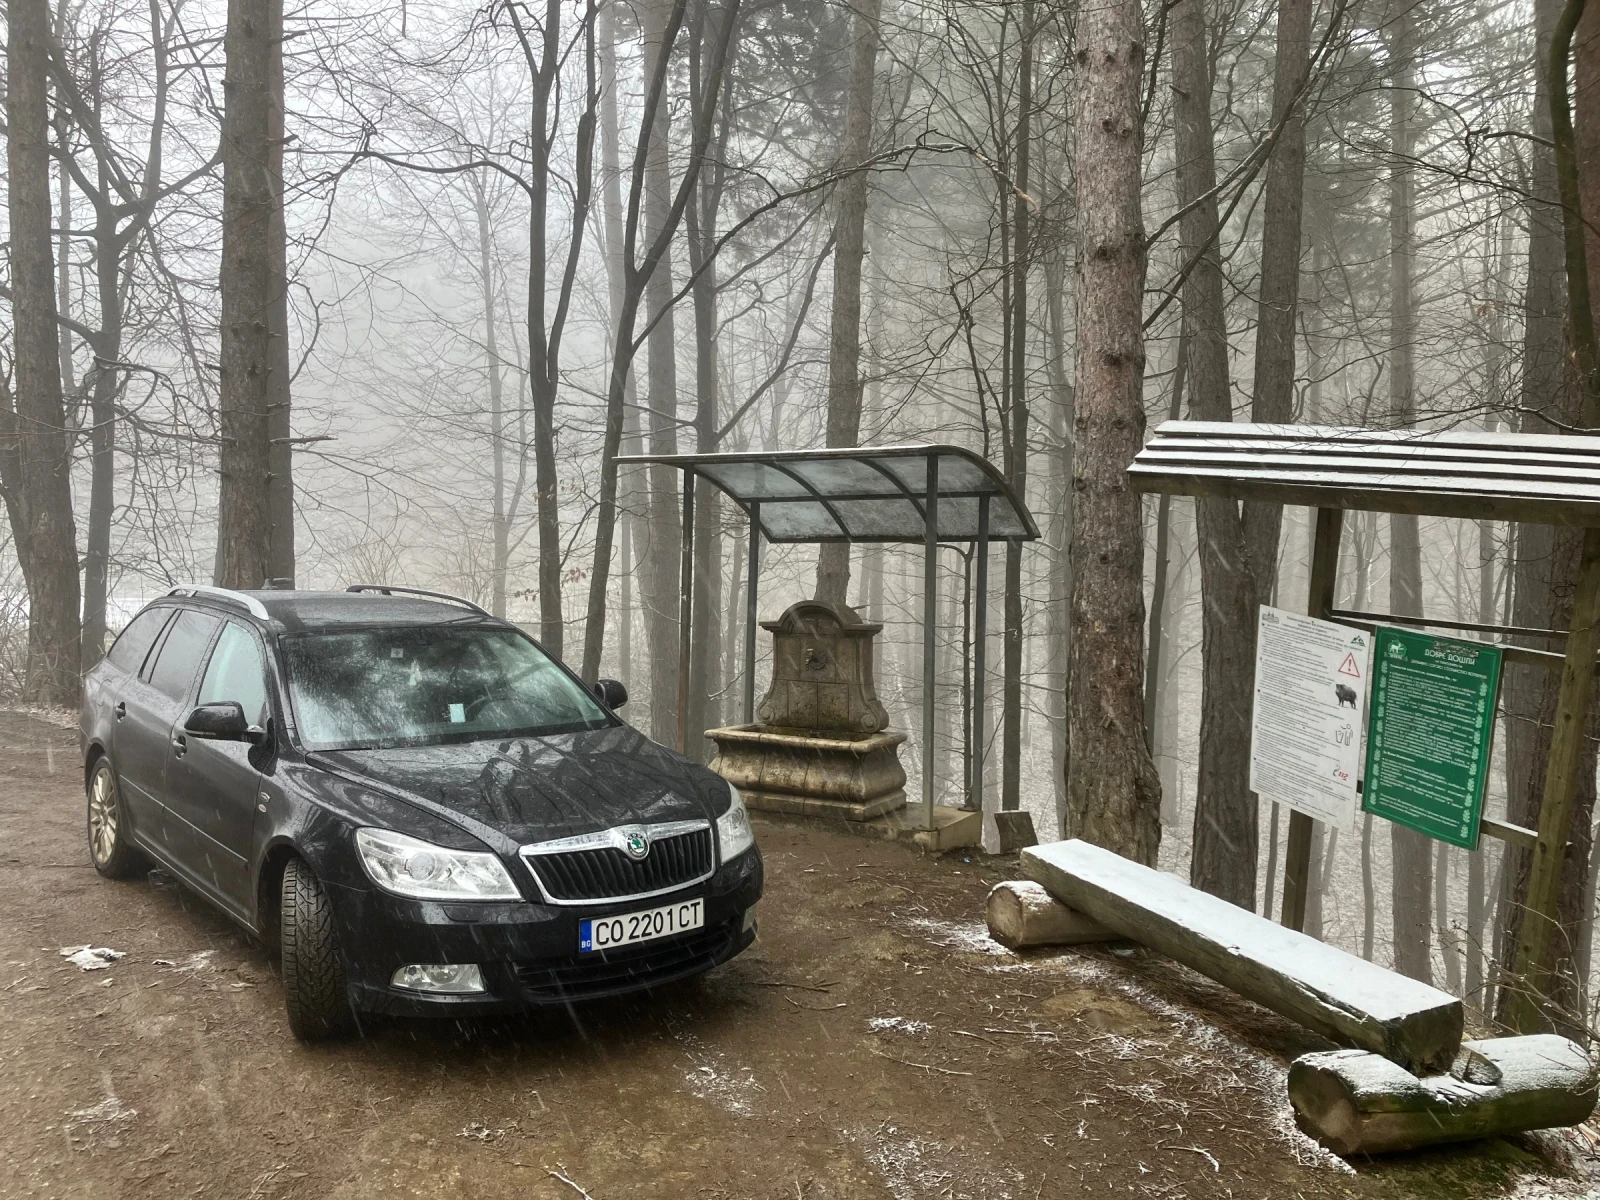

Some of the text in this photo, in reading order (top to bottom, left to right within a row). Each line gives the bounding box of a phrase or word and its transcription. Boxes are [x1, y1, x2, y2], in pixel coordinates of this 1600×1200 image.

[1424, 648, 1446, 660] ДОБРЕ
[1448, 654, 1476, 666] ДОШЛИ
[1338, 771, 1349, 782] 112
[596, 901, 701, 946] CO 2201 CT
[581, 940, 591, 949] BG
